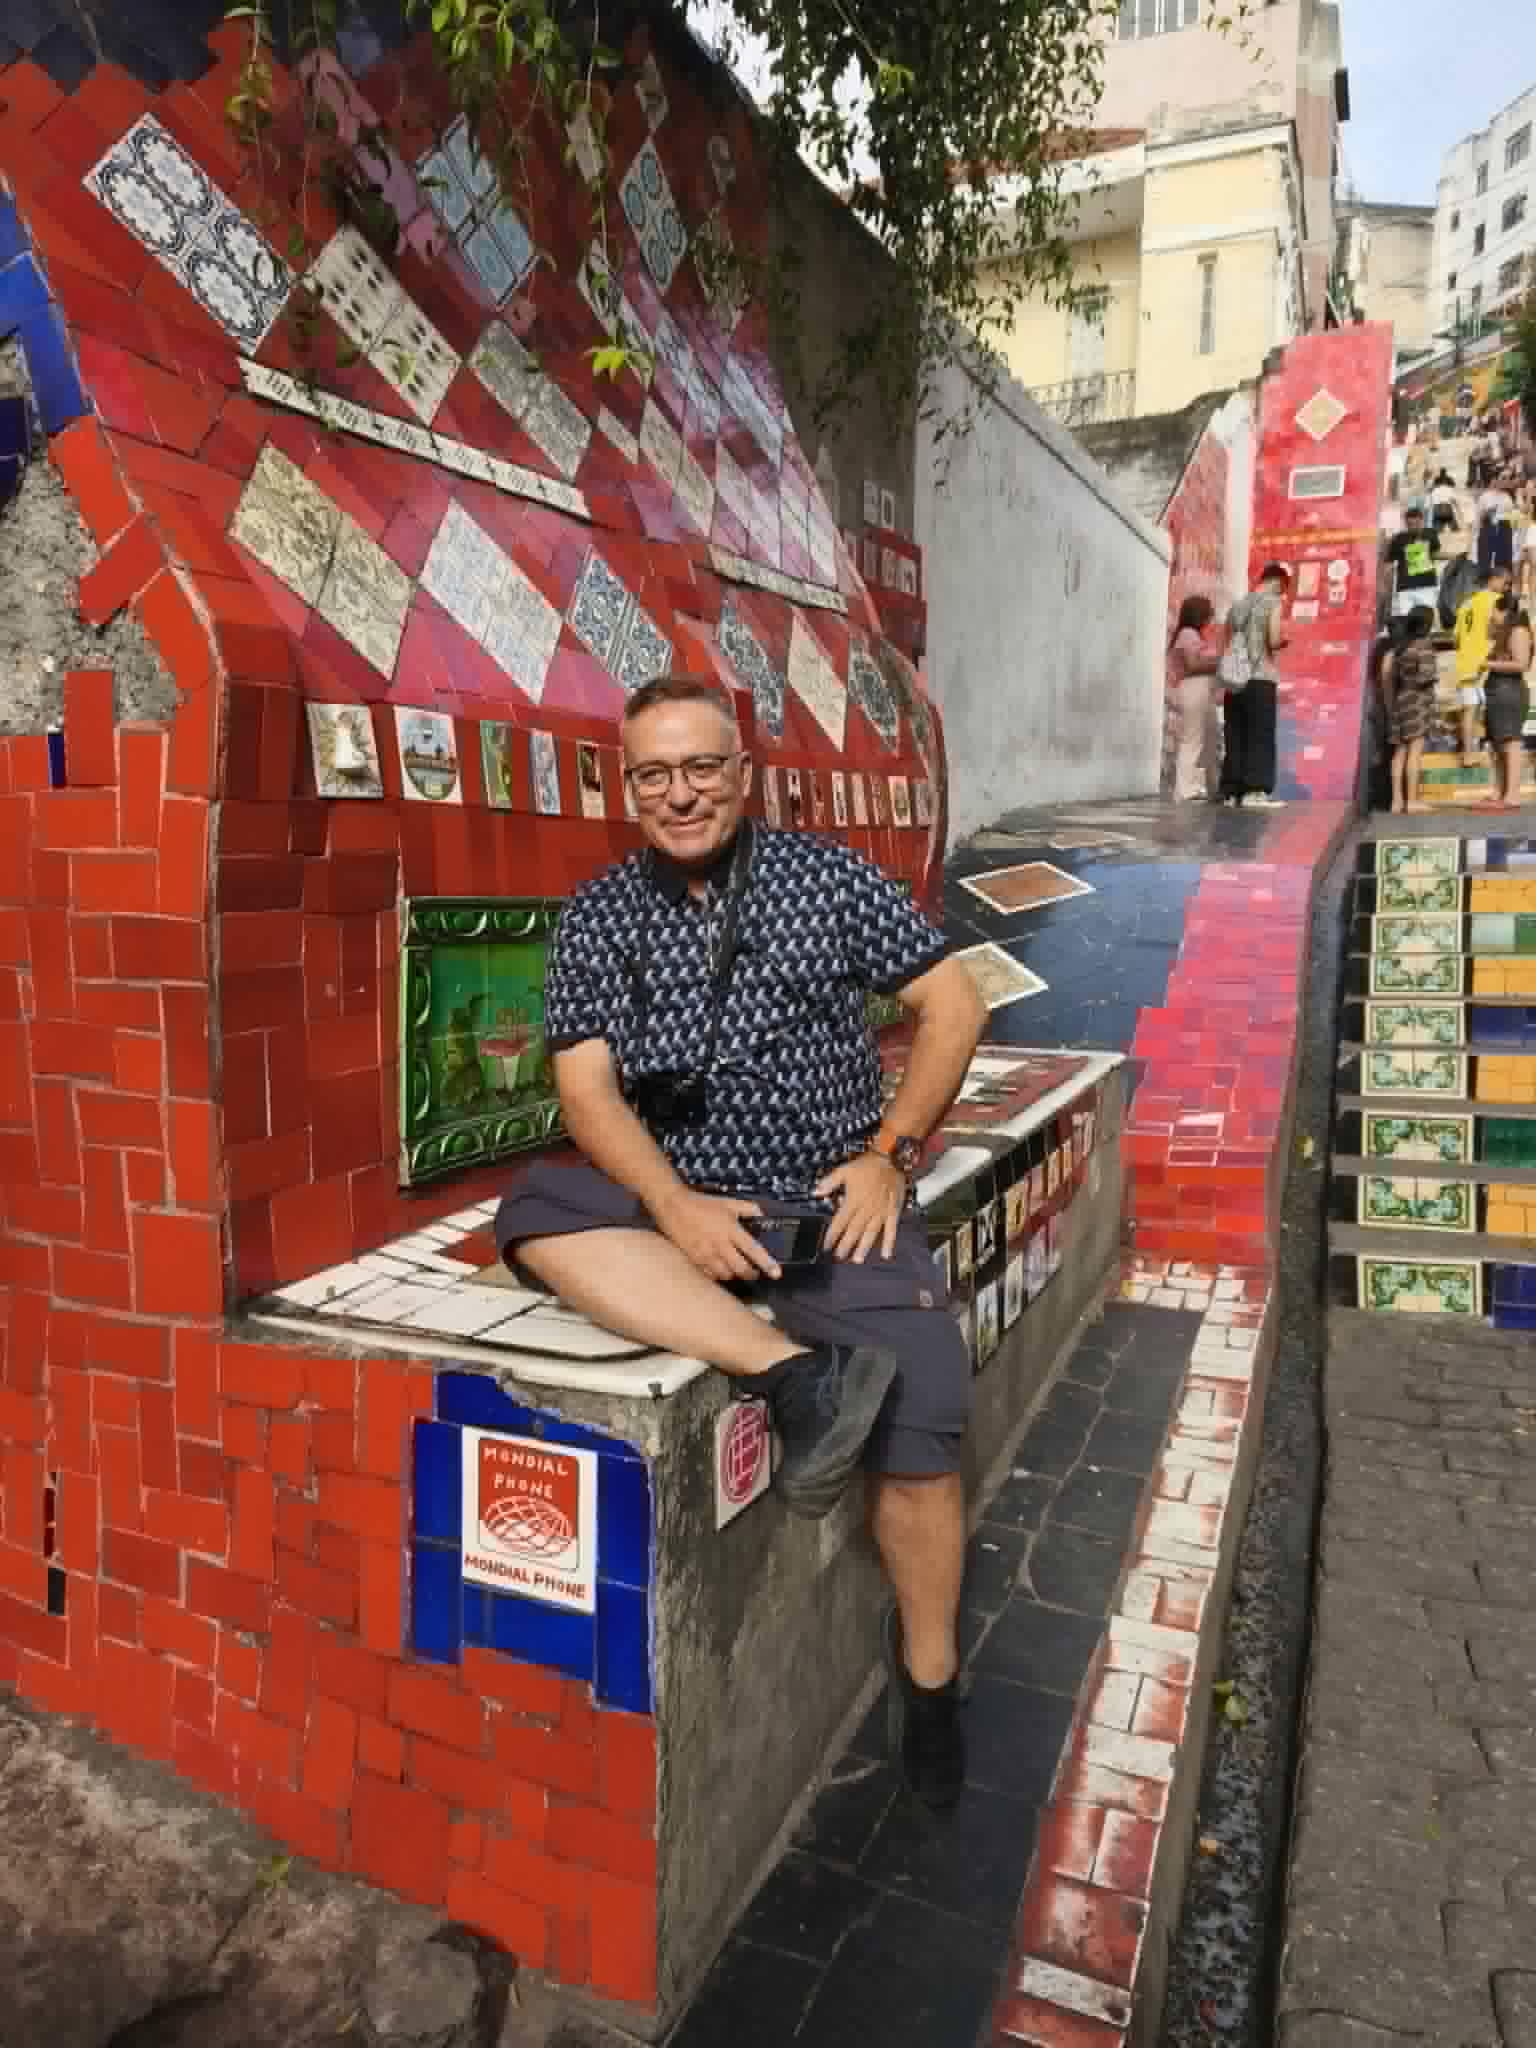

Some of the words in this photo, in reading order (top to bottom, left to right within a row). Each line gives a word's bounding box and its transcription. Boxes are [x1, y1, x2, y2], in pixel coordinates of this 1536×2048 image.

[483, 1446, 569, 1476] MONDIAL
[493, 1472, 553, 1500] PHONE
[464, 1554, 530, 1584] MONDIAL
[533, 1572, 586, 1599] PHONE
